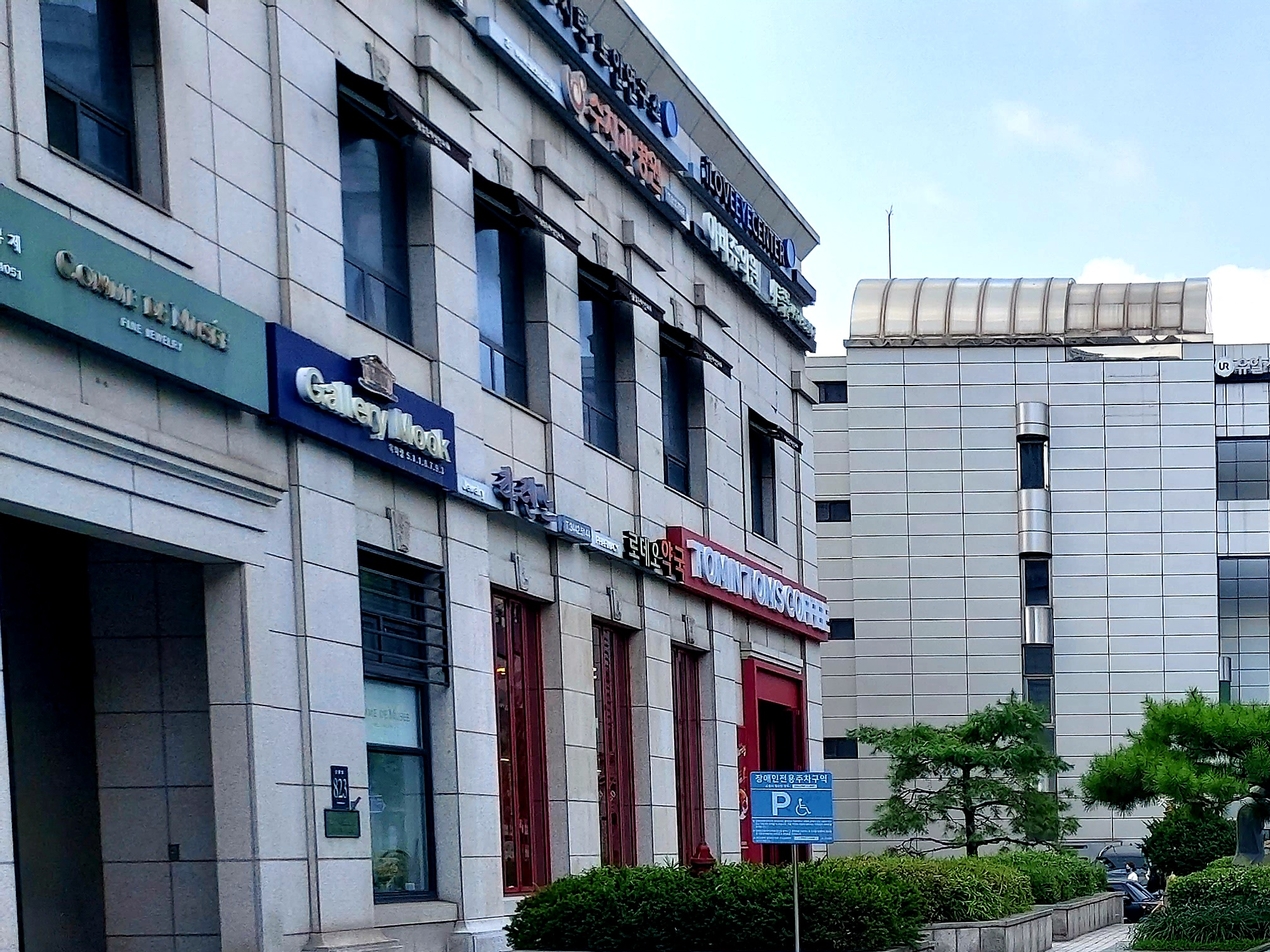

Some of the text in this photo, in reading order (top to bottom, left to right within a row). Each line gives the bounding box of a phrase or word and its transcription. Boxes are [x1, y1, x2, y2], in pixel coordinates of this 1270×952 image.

[1218, 362, 1230, 371] UR
[296, 366, 451, 463] Gallery Mook
[625, 531, 686, 583] 로데오약국
[755, 774, 828, 784] 장애인전용주차구역
[771, 791, 791, 816] P
